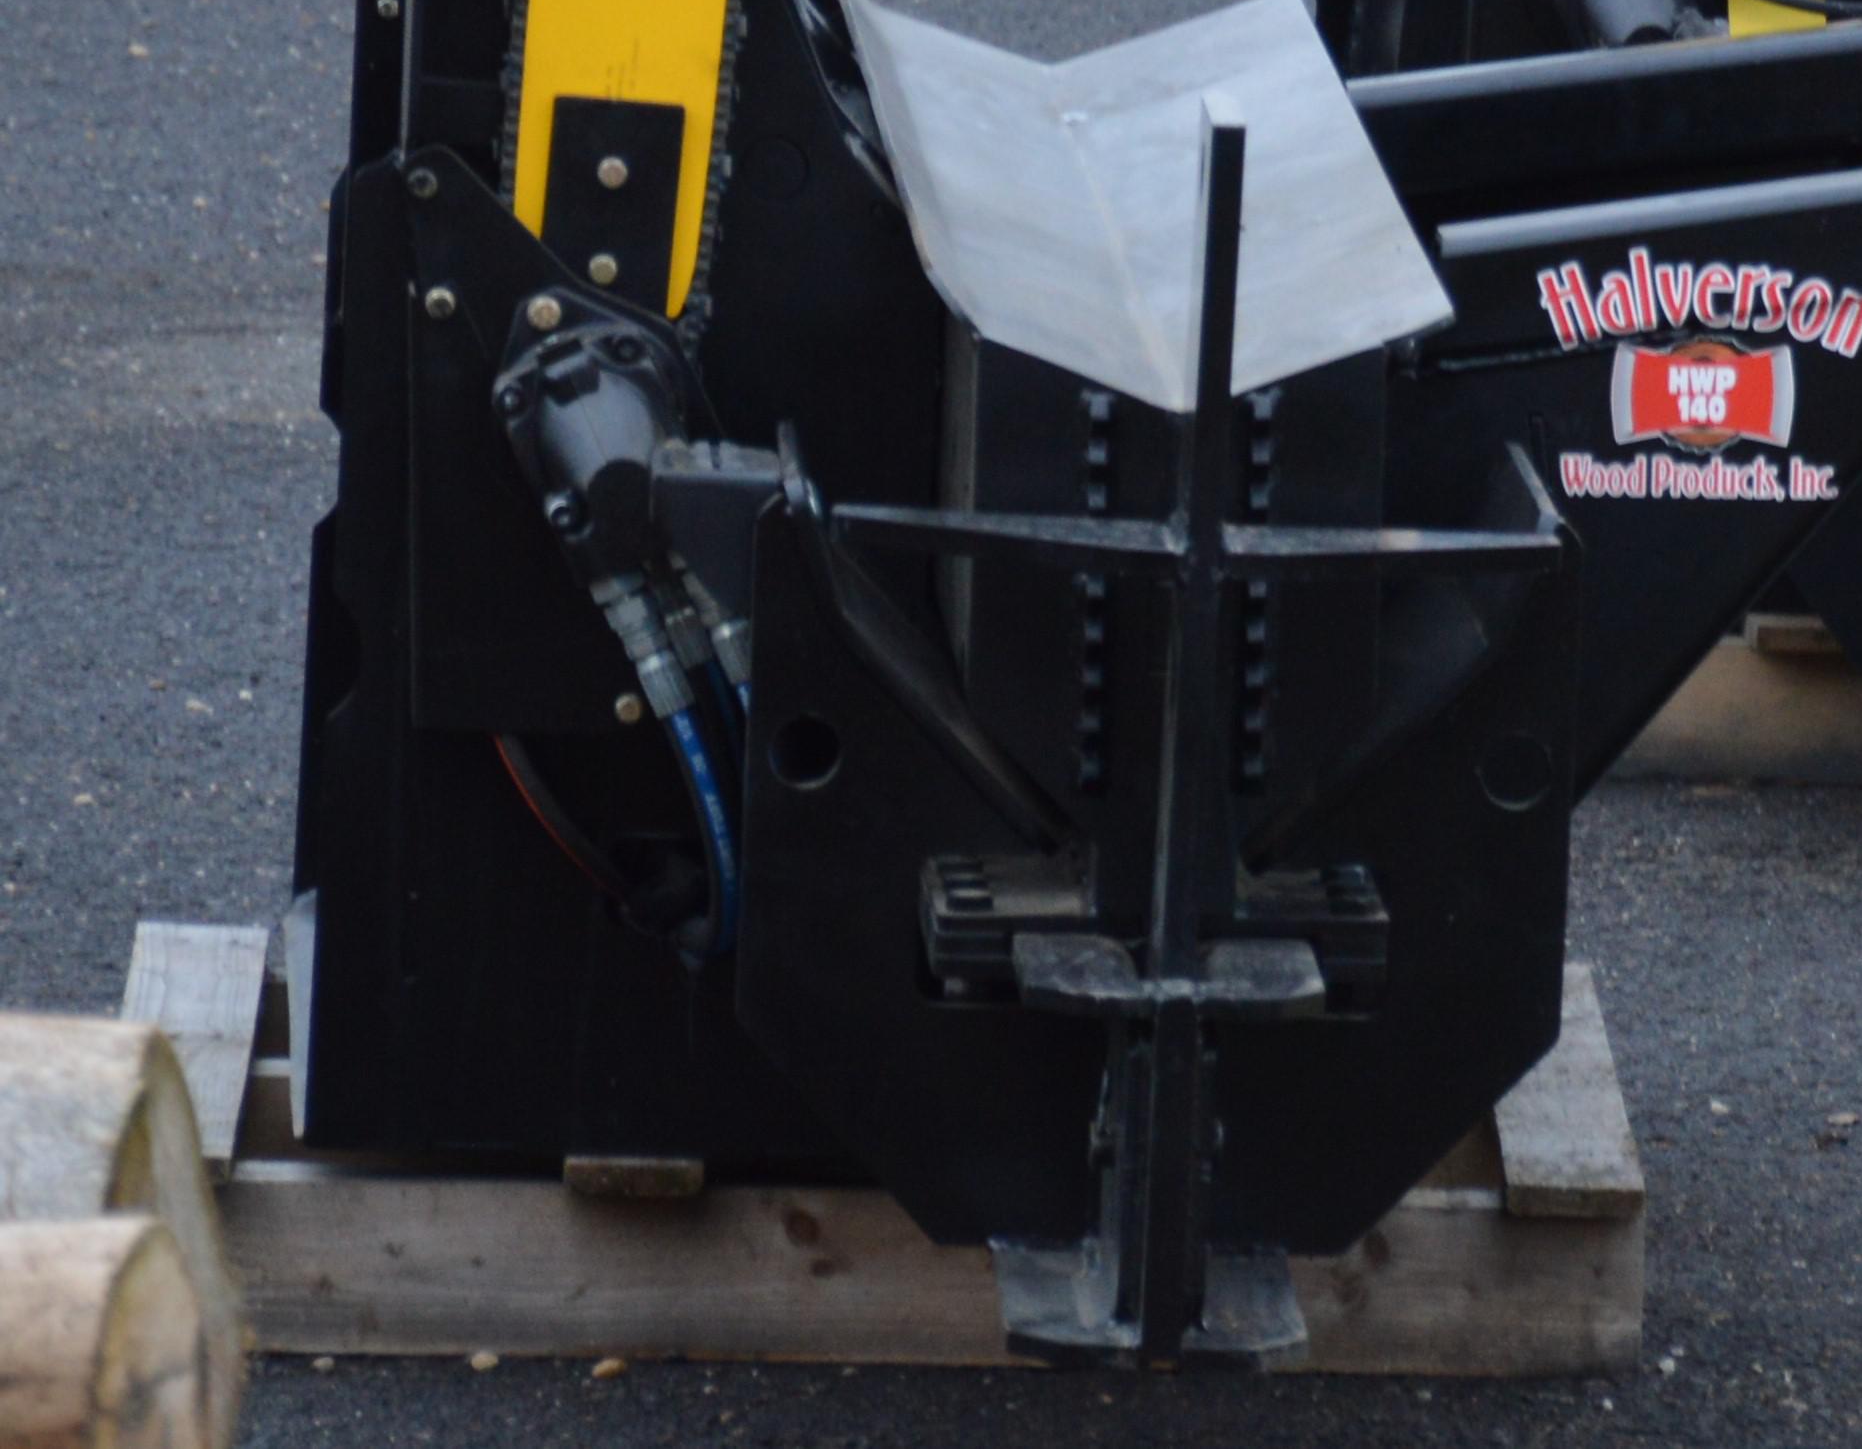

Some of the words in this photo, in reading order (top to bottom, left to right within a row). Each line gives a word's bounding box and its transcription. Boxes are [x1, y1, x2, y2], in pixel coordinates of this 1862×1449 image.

[1668, 364, 1737, 396] HWP
[1677, 394, 1727, 424] 140
[1559, 453, 1648, 499] Wood
[1650, 454, 1786, 503] Products,
[1789, 456, 1840, 501] Inc.
